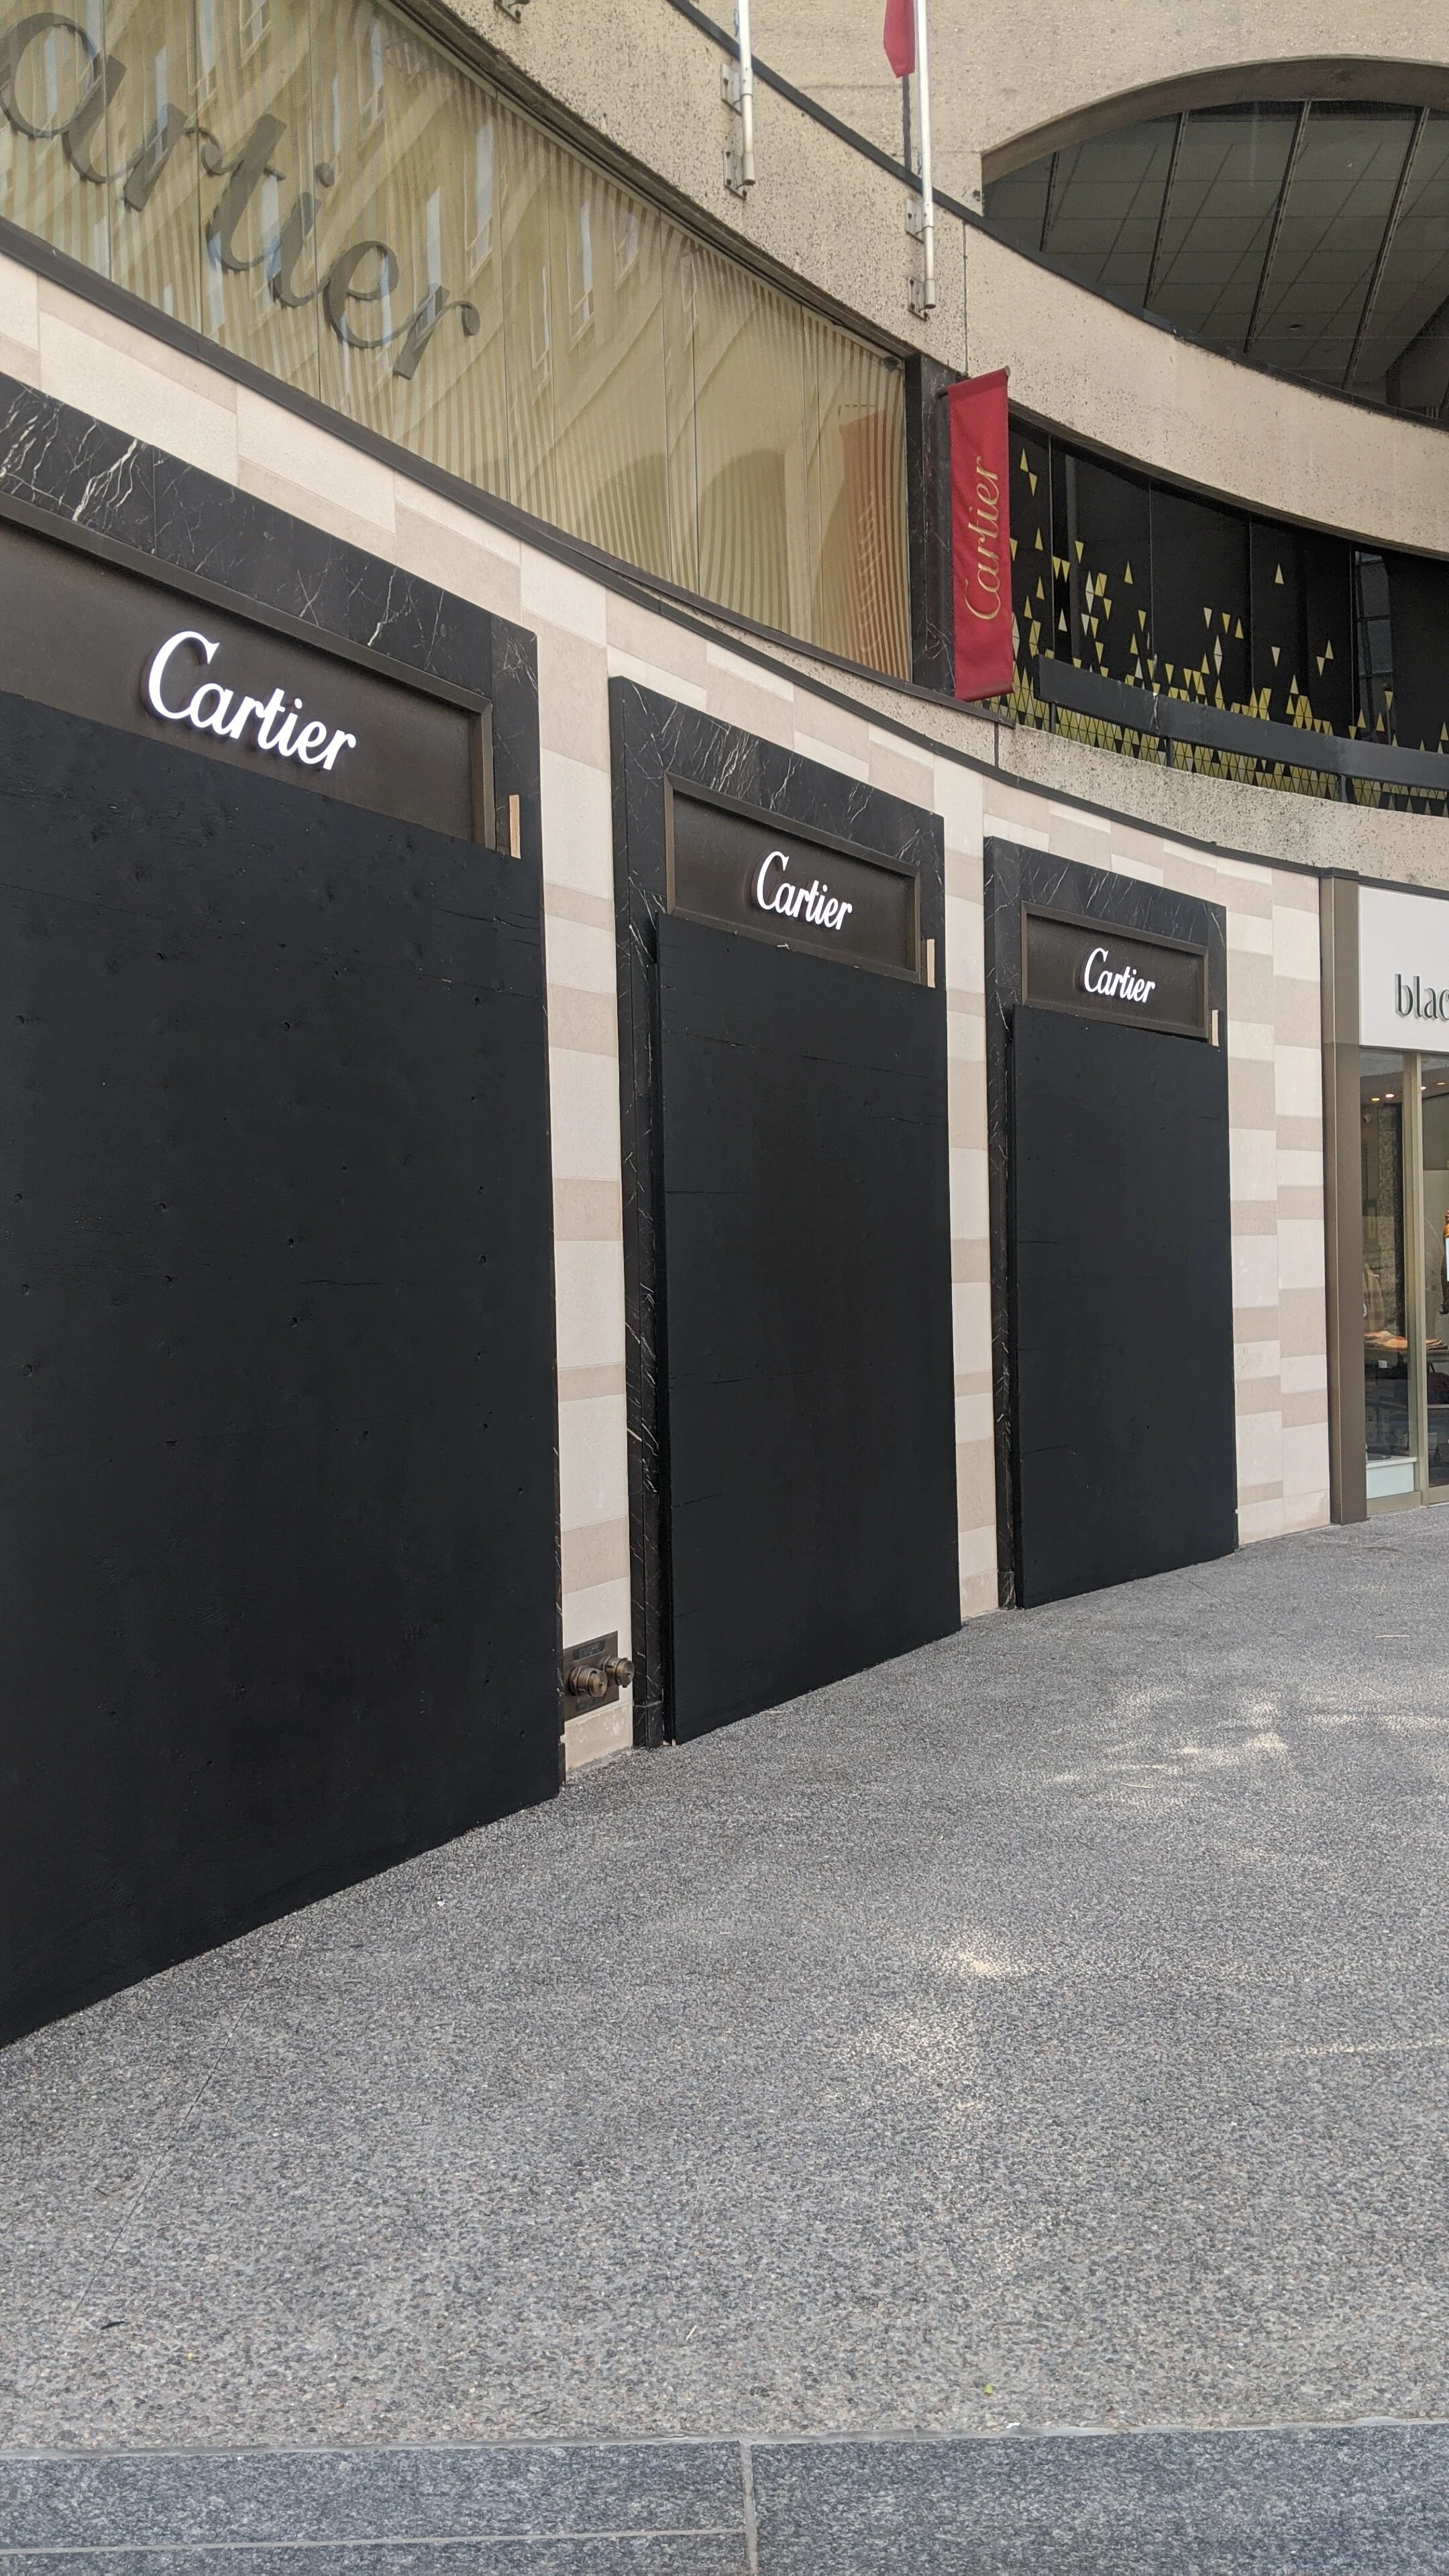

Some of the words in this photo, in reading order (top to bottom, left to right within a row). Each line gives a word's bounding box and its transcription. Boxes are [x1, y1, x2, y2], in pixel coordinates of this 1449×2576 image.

[964, 455, 1000, 620] Cartier
[148, 630, 357, 770] Cartier
[756, 851, 853, 930] Cartier
[1084, 947, 1156, 1003] Cartier
